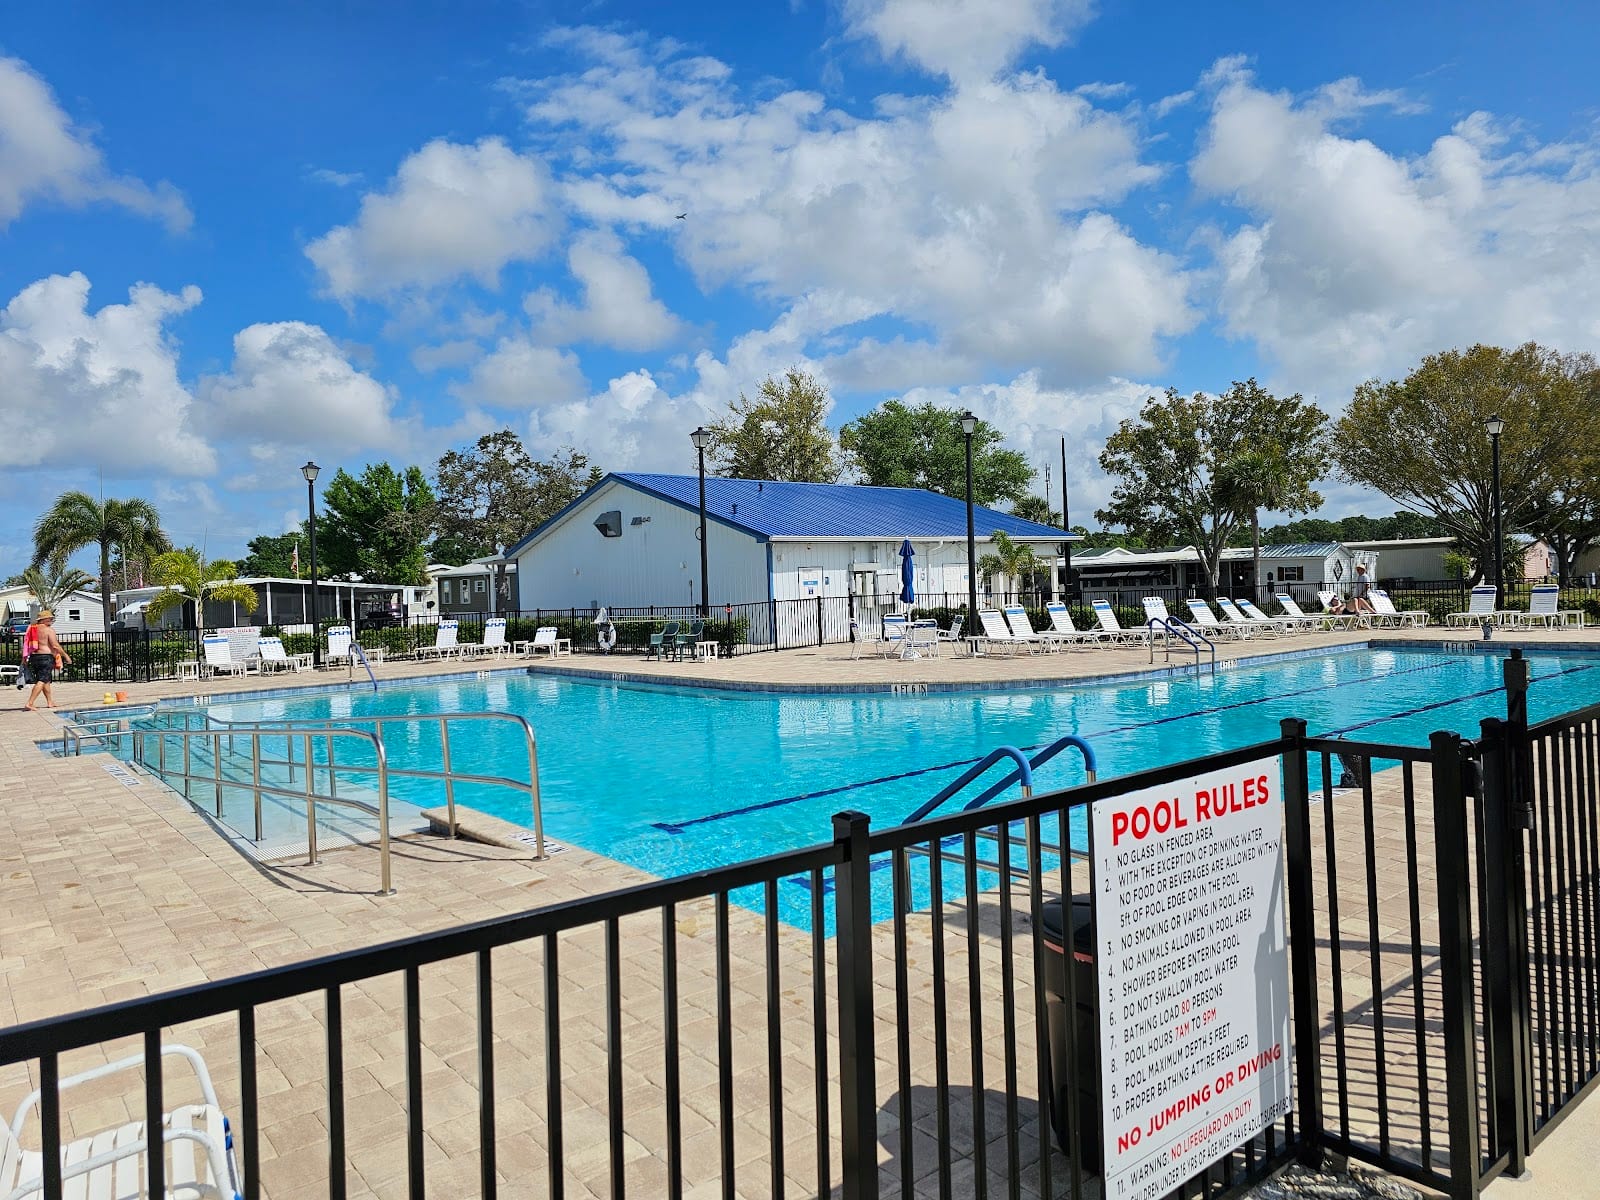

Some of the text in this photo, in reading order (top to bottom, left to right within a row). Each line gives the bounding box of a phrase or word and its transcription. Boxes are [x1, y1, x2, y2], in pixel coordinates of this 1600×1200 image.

[1112, 775, 1269, 847] POOL RULES
[1105, 826, 1214, 871] 1. NO GLASS IN FENCED AREA
[1105, 827, 1263, 893] 2. WITH THE EXCEPTION OF DRINKING WATER
[1120, 891, 1131, 907] NO
[1133, 883, 1155, 902] FOOD
[1157, 878, 1167, 893] OR
[1169, 863, 1210, 889] BEVERAGES
[1211, 858, 1224, 875] ARE
[1226, 847, 1256, 869] ALLOWED
[1121, 871, 1240, 928] 5ft OF POOL EDGE OR IN THE POOL
[1121, 933, 1133, 950] NO
[1135, 919, 1169, 945] SMOKING
[1171, 915, 1181, 930] OR
[1183, 904, 1209, 926] VAPING
[1211, 901, 1217, 915] IN
[1219, 893, 1237, 911] POOL
[1238, 886, 1255, 904] AREA
[1109, 908, 1252, 979] 4. NO ANIMALS ALLOWED IN POOL AREA
[1109, 933, 1240, 1003] 5. SHOWER BEFORE ENTERING POOL
[1110, 954, 1238, 1026] 6. DO NOT SWALLOW POOL WATER
[1110, 983, 1223, 1050] 7. BATHING LOAD 80 PERSONS
[1111, 1007, 1217, 1073] 8. POOL HOURS 7AM TO 9PM
[1112, 1022, 1231, 1099] 9. POOL MAXIMUM DEPTH 5 FEET
[1112, 1034, 1249, 1122] 10. PROPER BATHING ATTIRE REQUIRED
[1118, 1043, 1281, 1155] NO JUMPING OR DIVING
[1117, 1098, 1252, 1195] 11. WARNING: NO LIFEGUARD ON DUTY
[1161, 1167, 1180, 1191] UNDER
[1187, 1155, 1198, 1172] YRS
[1199, 1149, 1206, 1165] OF
[1207, 1141, 1218, 1159] AGE
[1219, 1132, 1232, 1151] MUST
[1233, 1123, 1247, 1143] HAVE
